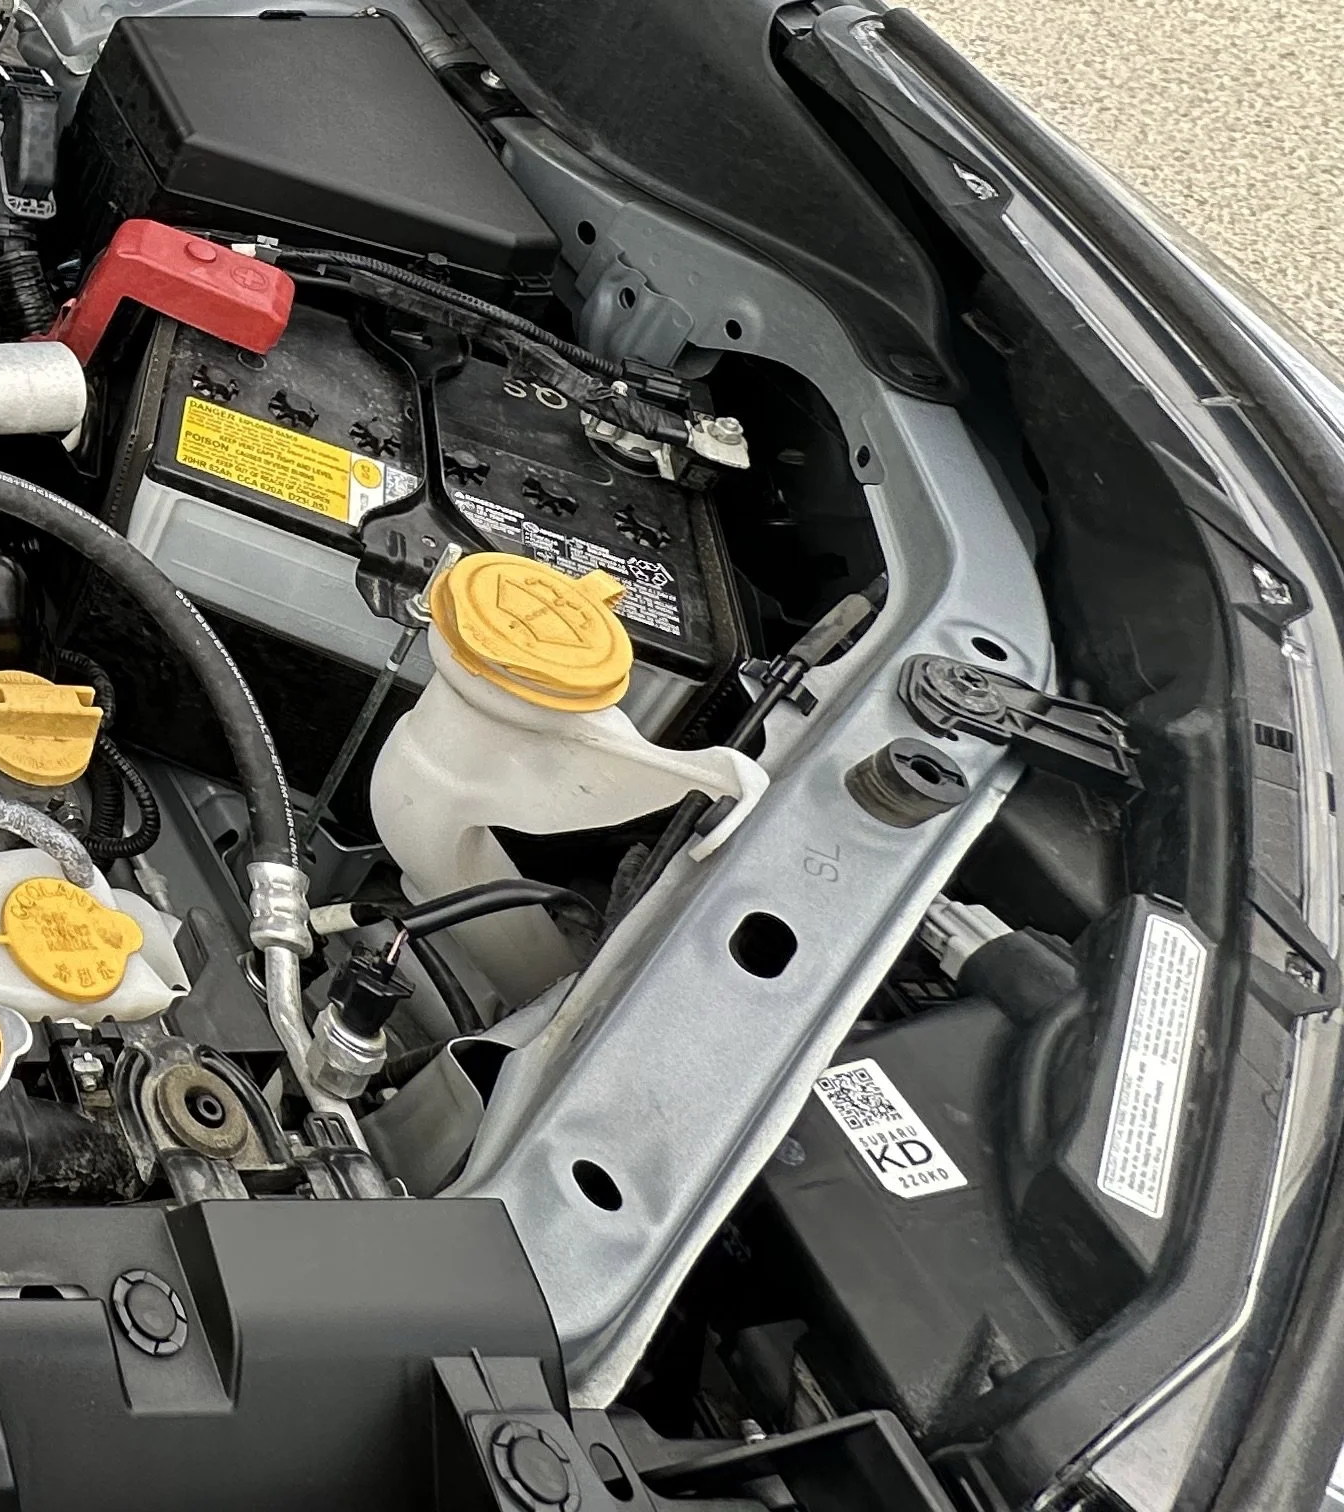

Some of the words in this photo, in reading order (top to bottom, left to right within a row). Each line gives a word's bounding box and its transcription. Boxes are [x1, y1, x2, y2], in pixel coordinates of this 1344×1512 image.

[189, 399, 235, 421] DANGER
[184, 429, 229, 452] POISON
[859, 1125, 917, 1148] SUBARU
[865, 1140, 933, 1173] KD
